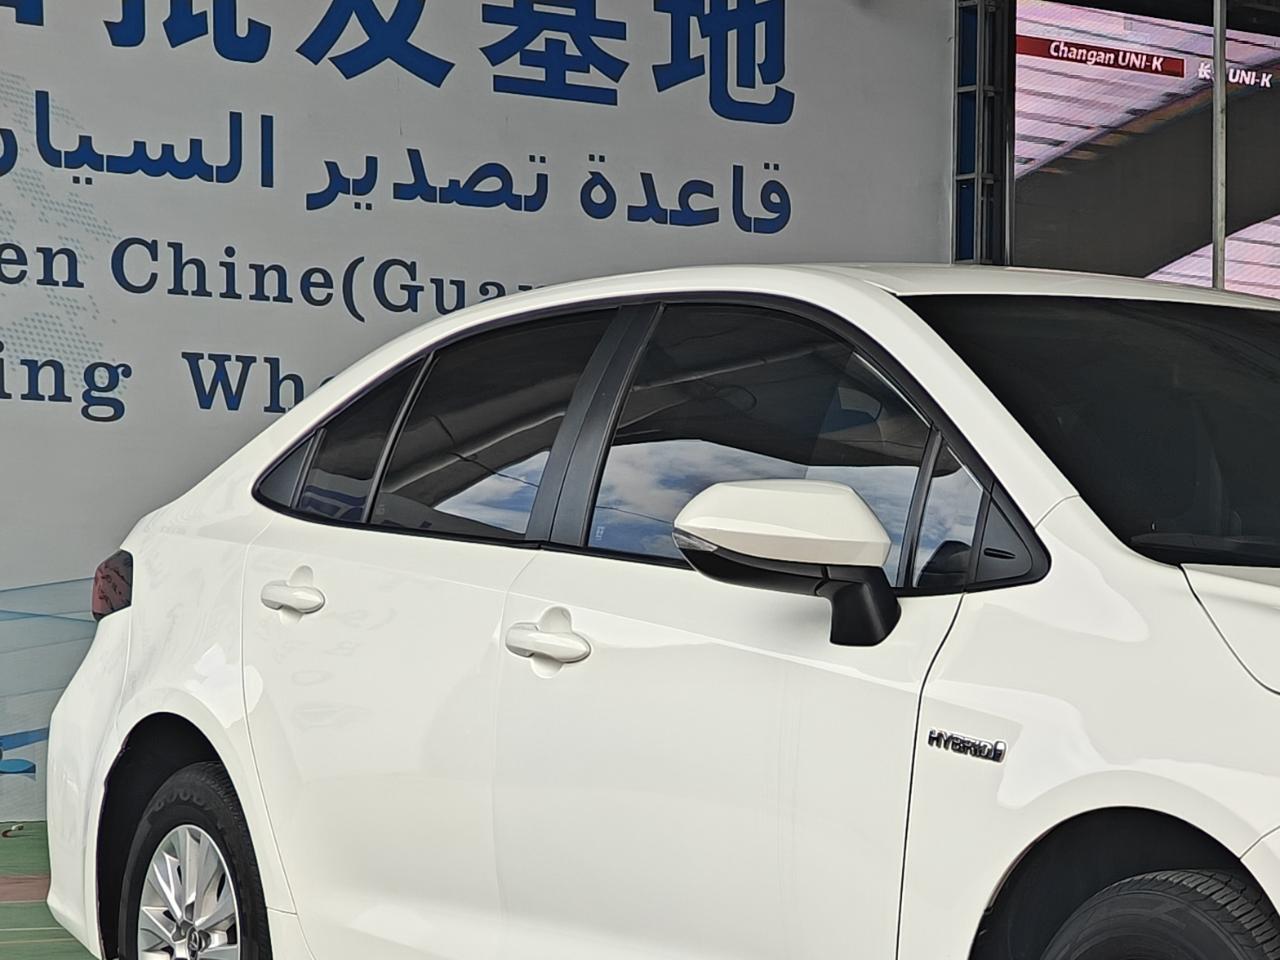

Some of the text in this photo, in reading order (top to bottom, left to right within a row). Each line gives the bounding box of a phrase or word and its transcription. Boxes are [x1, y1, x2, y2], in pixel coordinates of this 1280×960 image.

[0, 0, 796, 124] 发基地
[1049, 41, 1164, 72] Changan UNI-K
[1228, 68, 1273, 88] UNI-K
[306, 148, 550, 212] تصدير
[579, 154, 792, 234] قاعدة
[0, 237, 545, 322] en Chine(Gua
